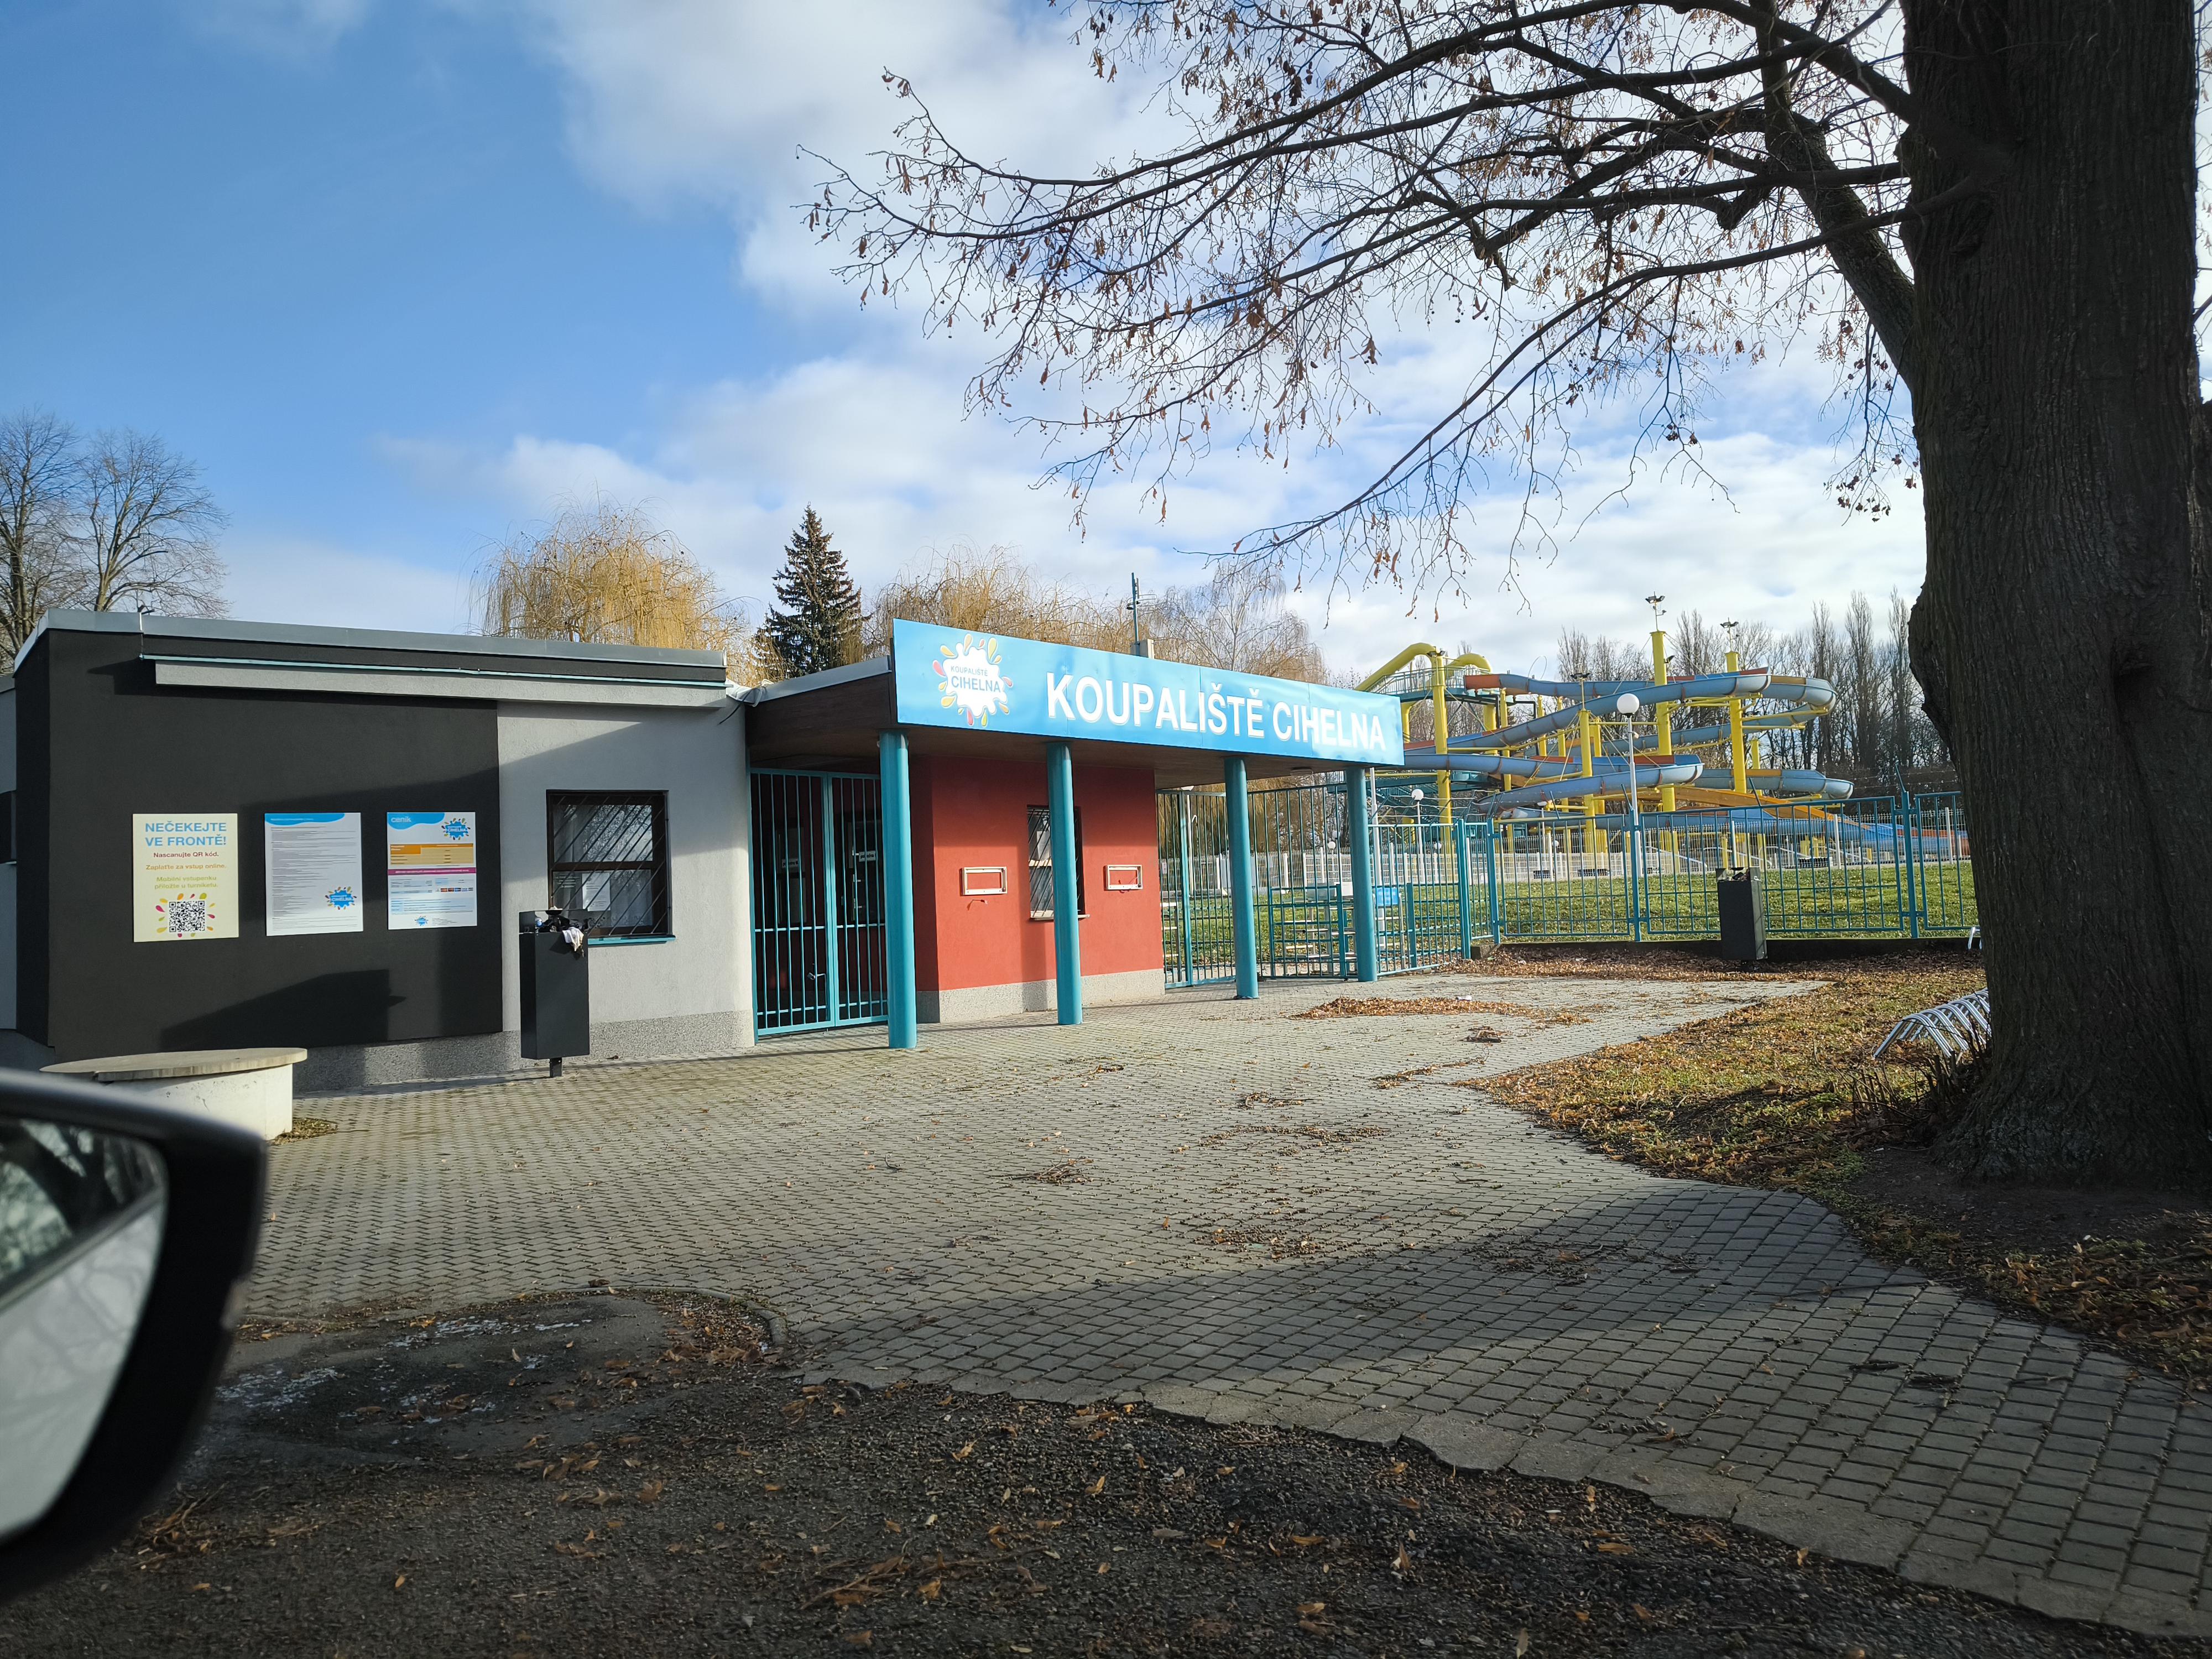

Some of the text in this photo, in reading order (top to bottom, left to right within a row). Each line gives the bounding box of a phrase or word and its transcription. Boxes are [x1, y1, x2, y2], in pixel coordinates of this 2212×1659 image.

[951, 665, 988, 676] KOUPALIŠTĚ
[951, 675, 1001, 693] CIHELNA
[1046, 672, 1386, 751] KOUPALIŠTĚ CIHELNA
[145, 820, 227, 832] NEČEKEJTE
[145, 834, 226, 846] VE FRONTĚ!
